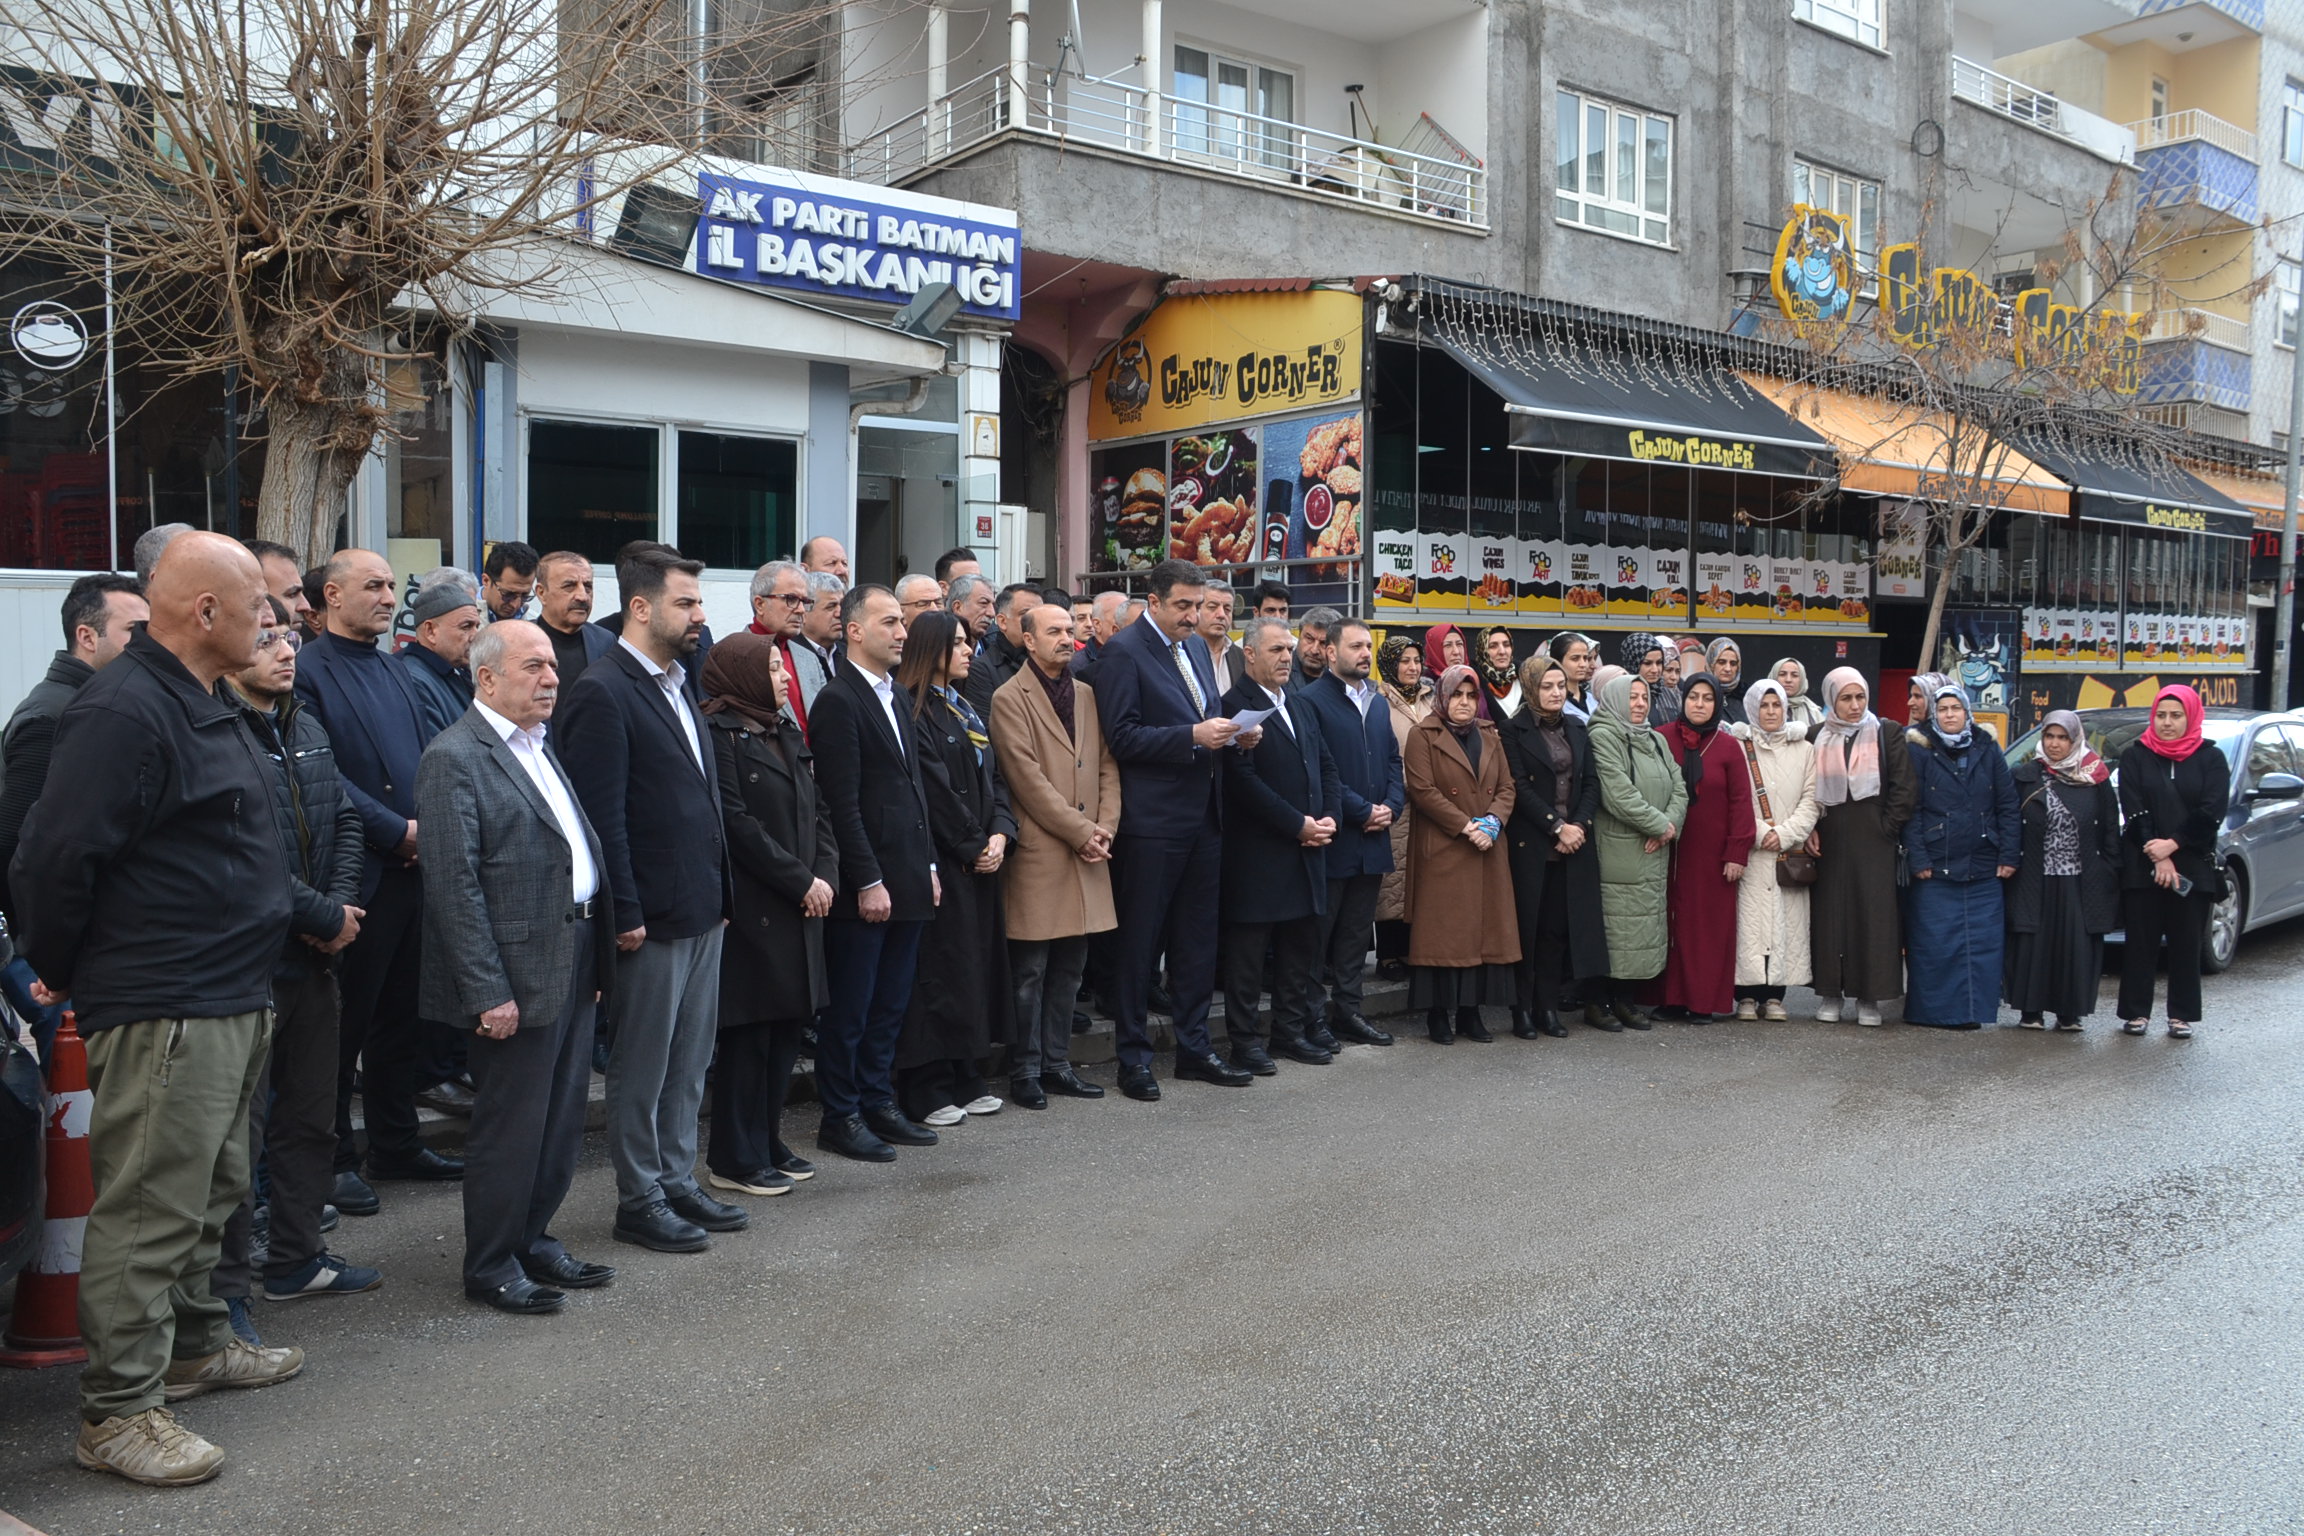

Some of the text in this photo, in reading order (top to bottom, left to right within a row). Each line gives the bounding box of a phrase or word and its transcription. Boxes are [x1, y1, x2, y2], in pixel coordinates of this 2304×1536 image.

[708, 187, 765, 224] AK
[877, 215, 1015, 264] BATMAN
[1160, 344, 1341, 404] CAJUN CORNER
[1628, 430, 1755, 470] CAJUN CORNER
[1379, 543, 1413, 557] CHICKEN
[1431, 544, 1456, 562] FOOD
[1483, 546, 1504, 558] CAJUN
[1571, 553, 1589, 563] CAJUN
[1394, 557, 1413, 571] TACO
[1431, 559, 1454, 574] LOVE
[1529, 550, 1552, 569] FOOD
[1618, 555, 1639, 574] FOOD
[1657, 560, 1680, 575] CAJUN
[1532, 564, 1551, 581] ART
[1618, 570, 1636, 583] LOVE
[1667, 574, 1680, 585] ROLL
[1743, 563, 1762, 580] FOOD
